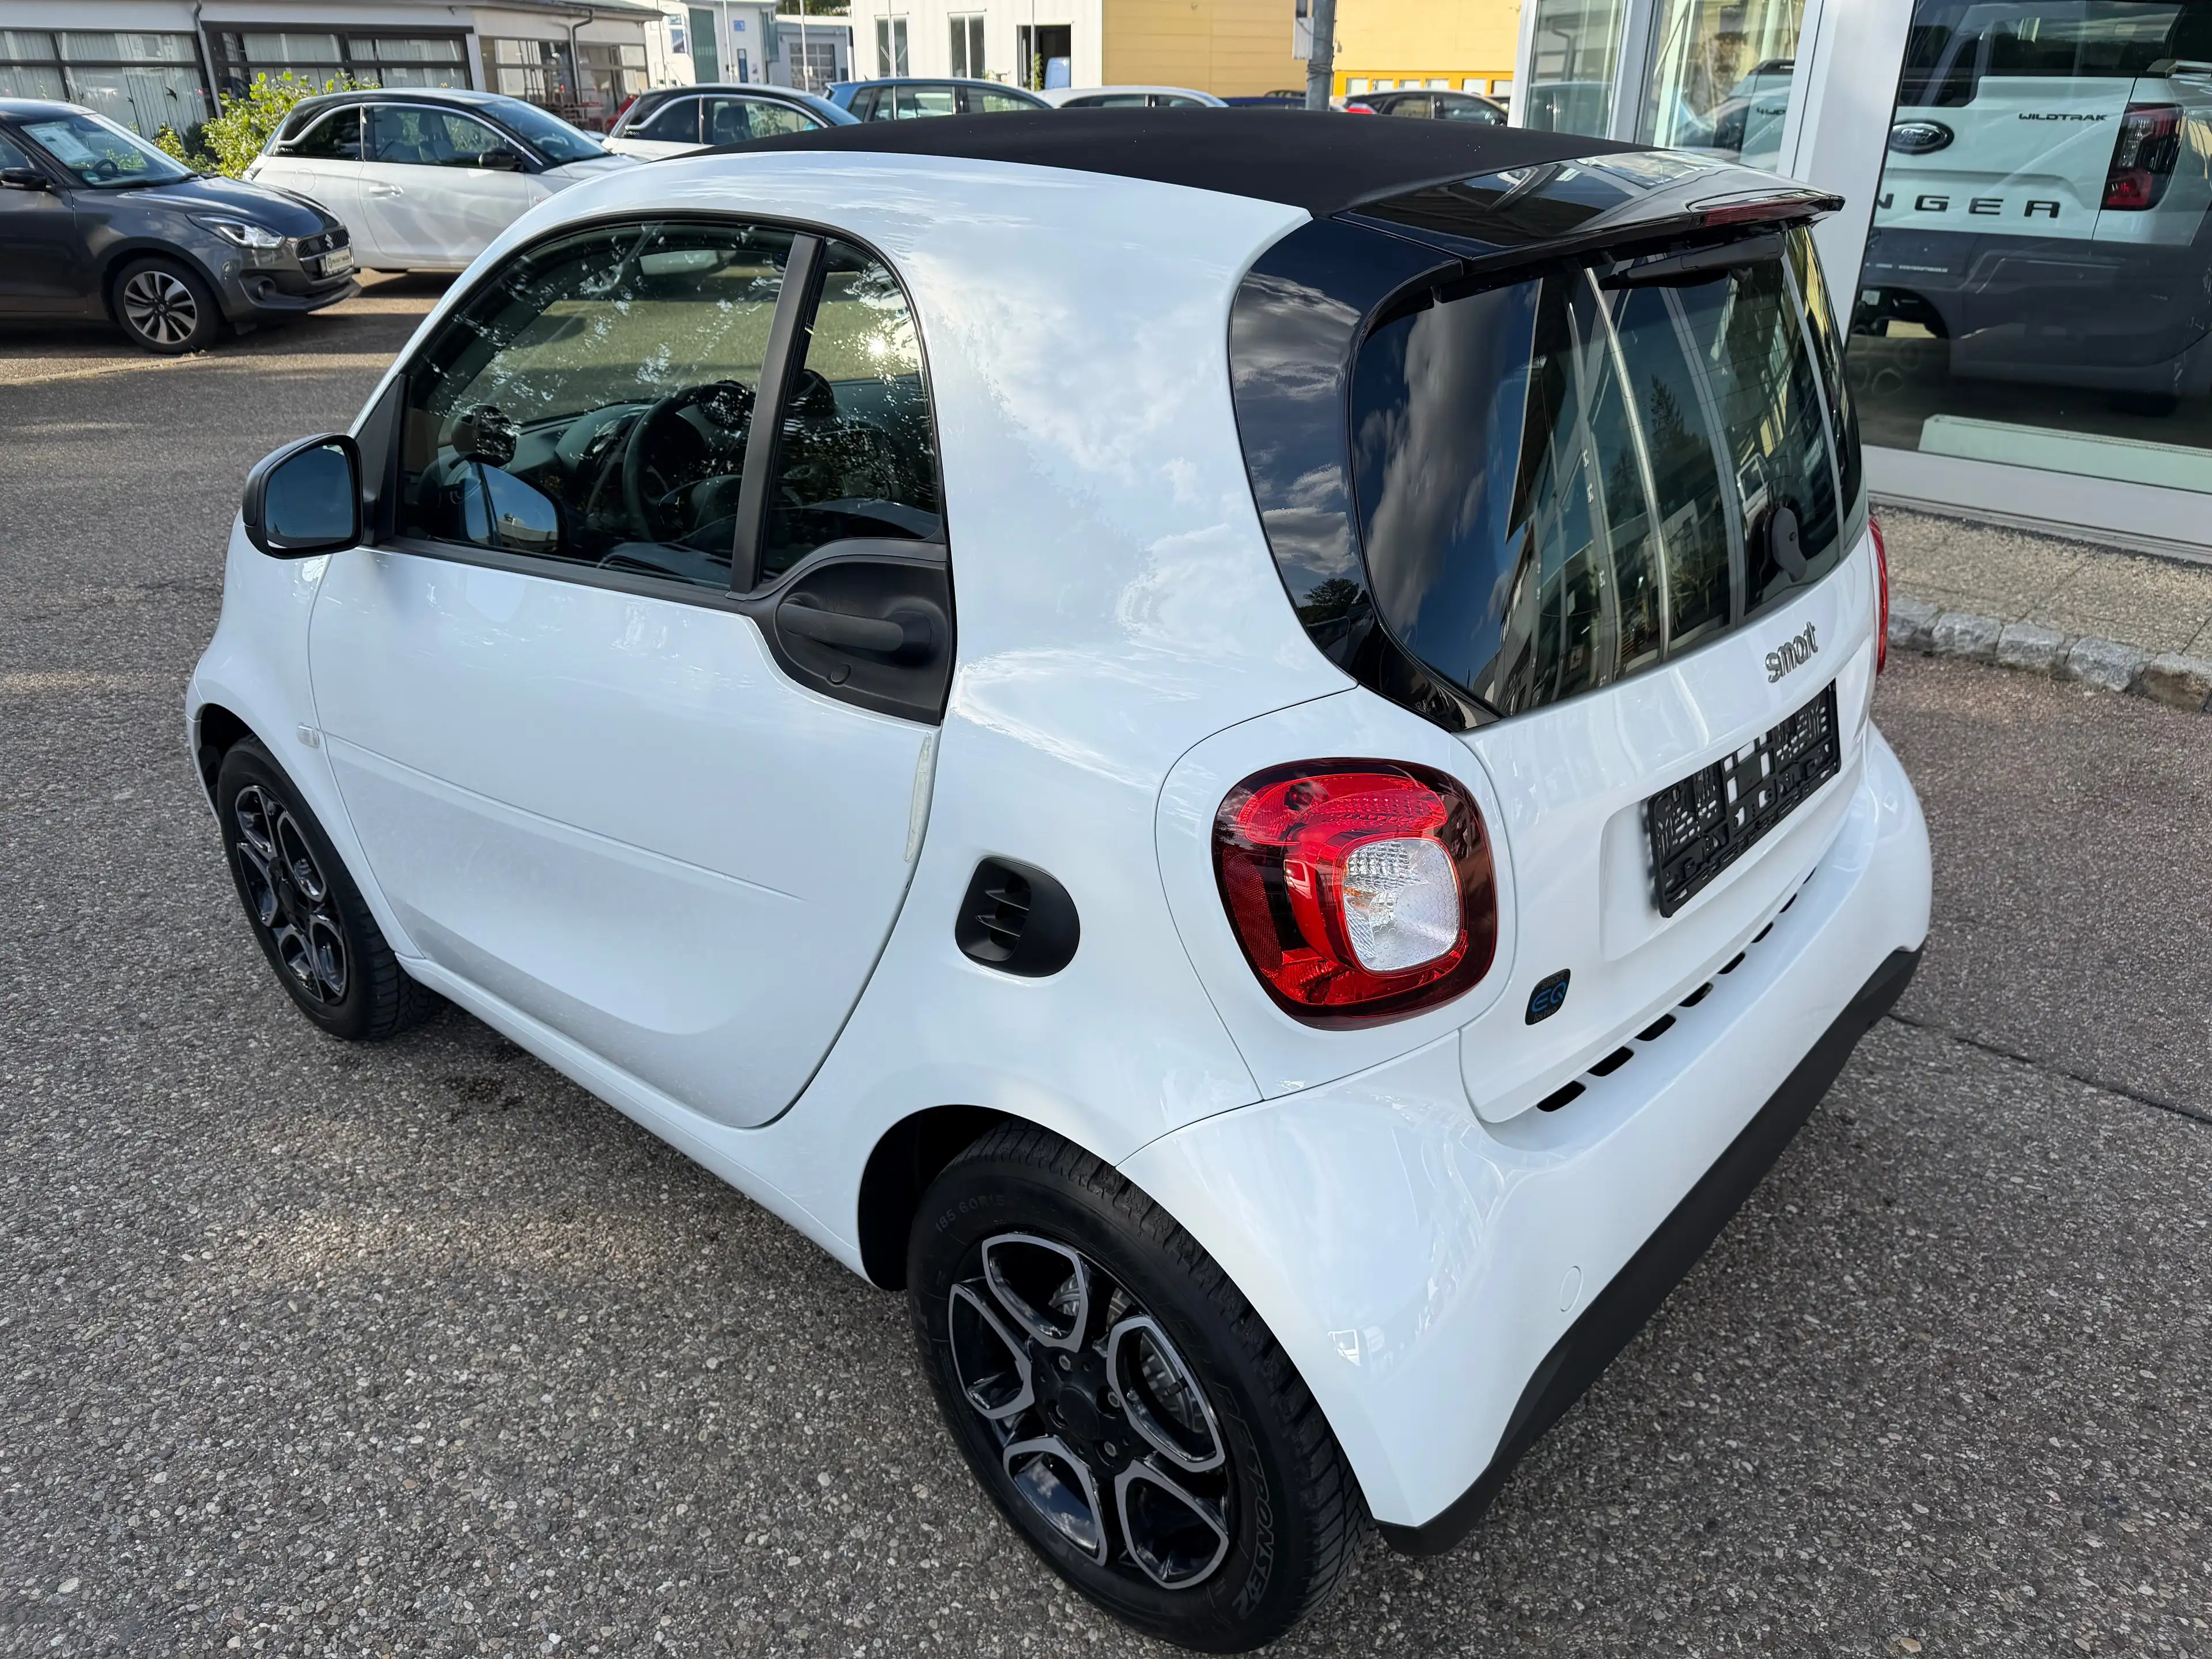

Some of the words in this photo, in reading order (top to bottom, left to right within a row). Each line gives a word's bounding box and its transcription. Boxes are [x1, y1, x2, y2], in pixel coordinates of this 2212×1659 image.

[2018, 113, 2107, 121] WILDTRAK
[1897, 128, 1934, 144] Ford
[1765, 622, 1818, 683] smart
[1531, 982, 1567, 1013] EQ
[935, 1209, 956, 1233] 185
